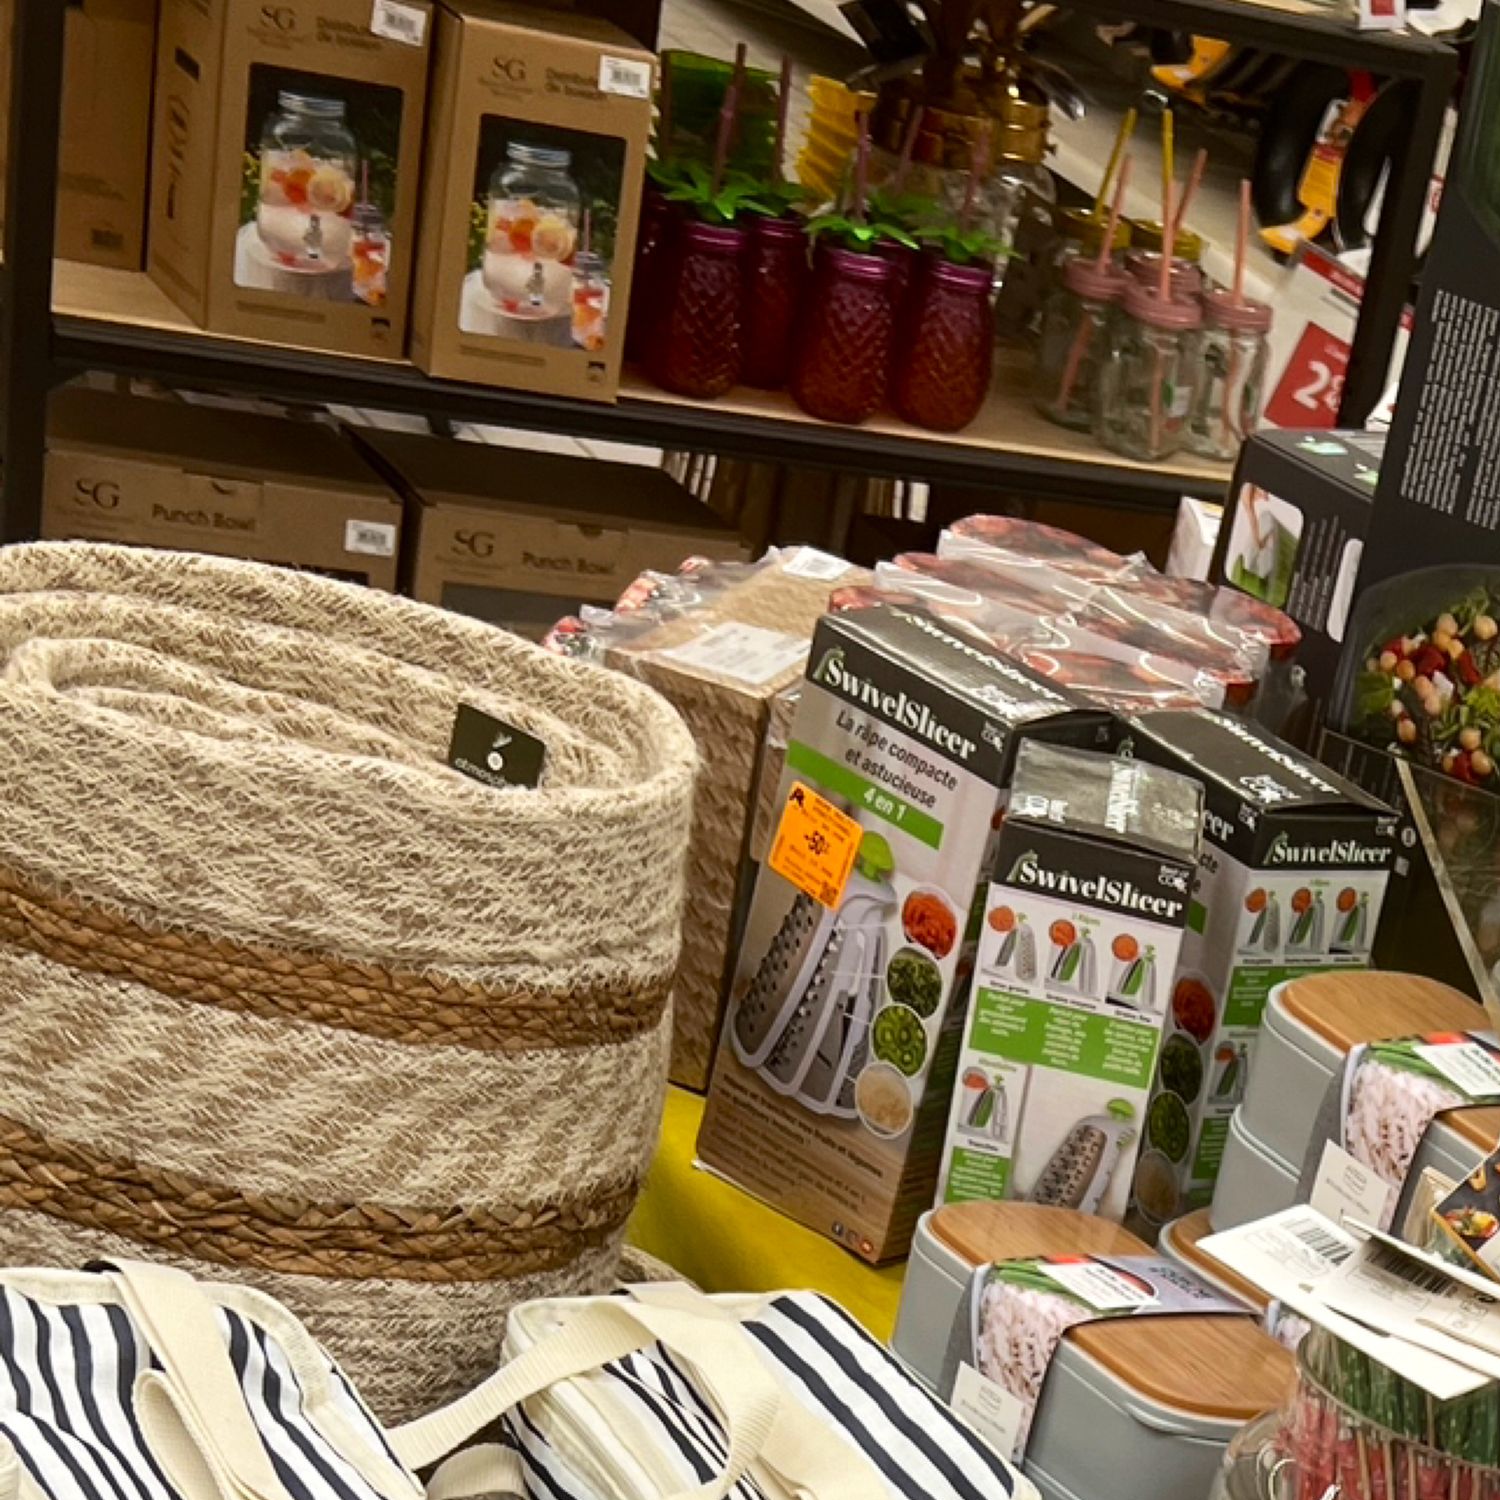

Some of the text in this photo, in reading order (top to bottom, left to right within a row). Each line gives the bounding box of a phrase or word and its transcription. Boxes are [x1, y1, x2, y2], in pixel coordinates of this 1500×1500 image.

[73, 478, 120, 509] SG
[152, 503, 256, 531] Punch Bowl
[451, 528, 495, 558] SG
[522, 552, 617, 575] Punch Bowl
[826, 656, 977, 762] SwivelSlicer
[836, 709, 958, 791] La râpe compacte
[844, 747, 936, 808] et astucieuse
[863, 787, 876, 804] 4
[1273, 839, 1392, 864] SwivelSlicer
[1020, 860, 1183, 919] SwivelSlicer
